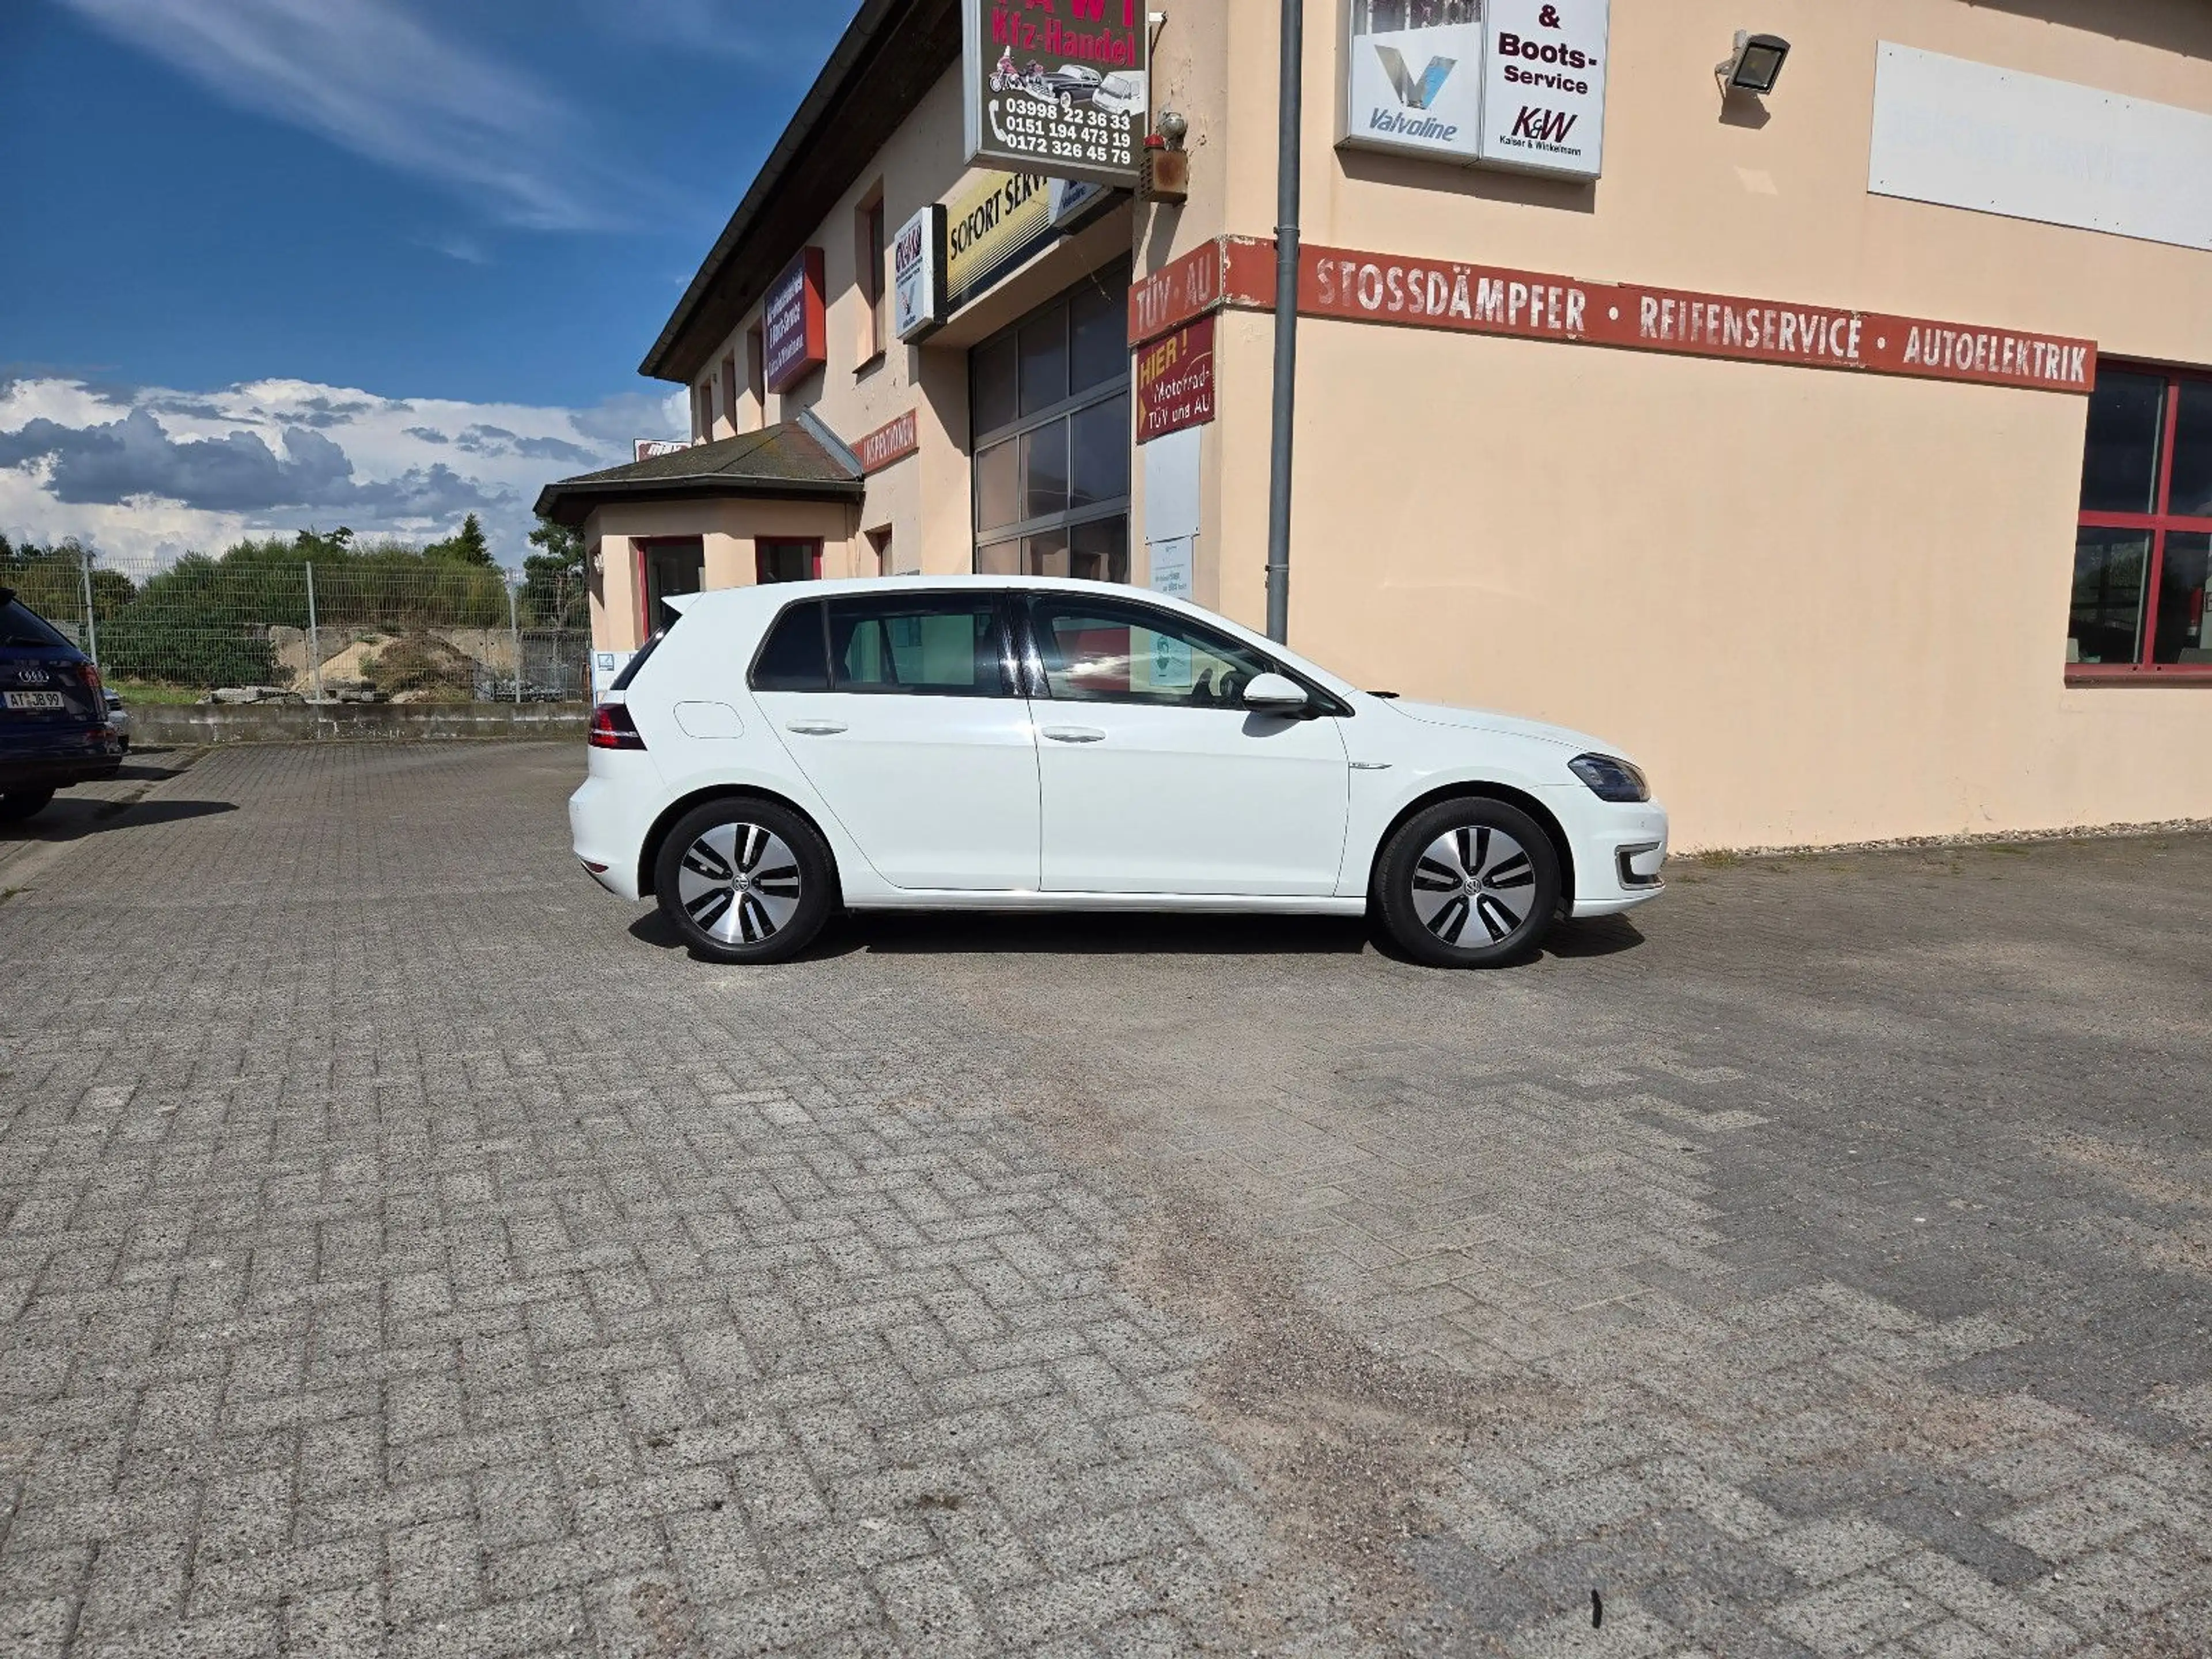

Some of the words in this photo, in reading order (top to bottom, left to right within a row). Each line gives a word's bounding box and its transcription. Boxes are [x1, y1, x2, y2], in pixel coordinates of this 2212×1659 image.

[1538, 4, 1560, 29] &
[992, 7, 1135, 67] Kfz-Handel
[1498, 32, 1597, 69] Boots-
[1504, 65, 1588, 95] Service
[1006, 98, 1057, 119] 03998
[1064, 108, 1084, 124] 22
[1087, 111, 1107, 127] 36
[1110, 115, 1130, 130] 33
[1369, 108, 1458, 142] Valvoline
[1006, 116, 1044, 135] 0151
[1049, 122, 1077, 139] 194
[1081, 127, 1108, 145] 473
[1112, 132, 1130, 147] 19
[1500, 135, 1525, 147] Kaiser
[1528, 140, 1533, 149] &
[1007, 133, 1047, 153] 0172
[1052, 141, 1082, 158] 326
[1086, 145, 1107, 161] 45
[1111, 149, 1131, 164] 79
[951, 188, 1002, 260] SOFORT
[1137, 272, 1171, 332] TÜV
[1186, 253, 1210, 306] AU
[1317, 257, 1586, 332] STOSSDÄMPFER
[1639, 295, 1862, 358] REIFENSERVICE
[1903, 325, 2088, 383] AUTOELEKTRIK
[1149, 407, 1168, 430] TÜV
[1194, 394, 1210, 414] AU
[11, 694, 24, 707] AT
